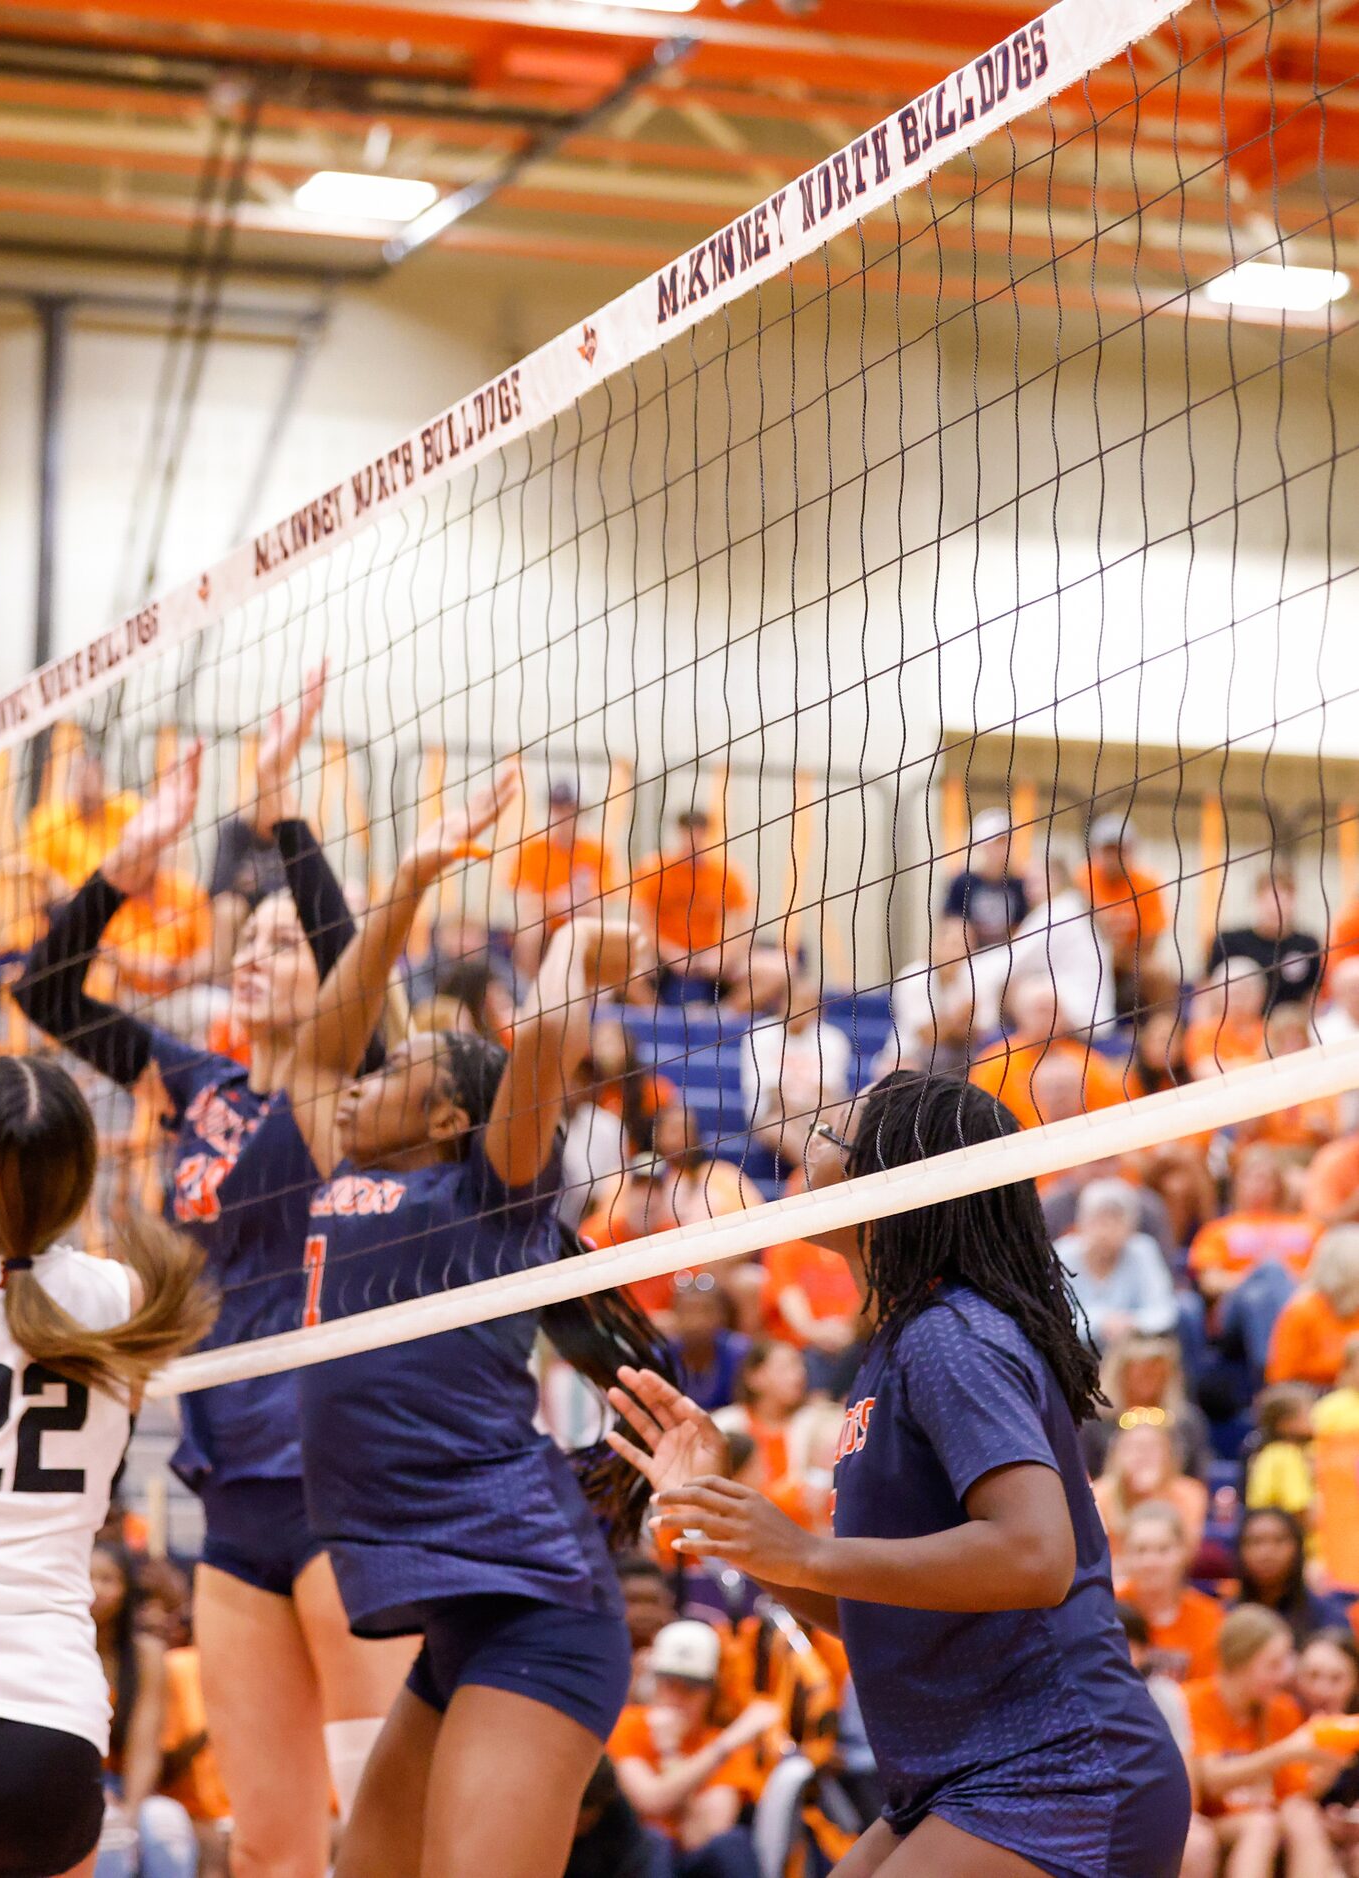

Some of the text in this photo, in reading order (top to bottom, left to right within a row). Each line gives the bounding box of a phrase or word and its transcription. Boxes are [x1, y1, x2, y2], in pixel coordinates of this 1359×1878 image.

[798, 122, 891, 232] NORTH
[897, 18, 1049, 167] BULLDOGS
[420, 369, 522, 476] BULLDOGS
[302, 1234, 328, 1328] 1
